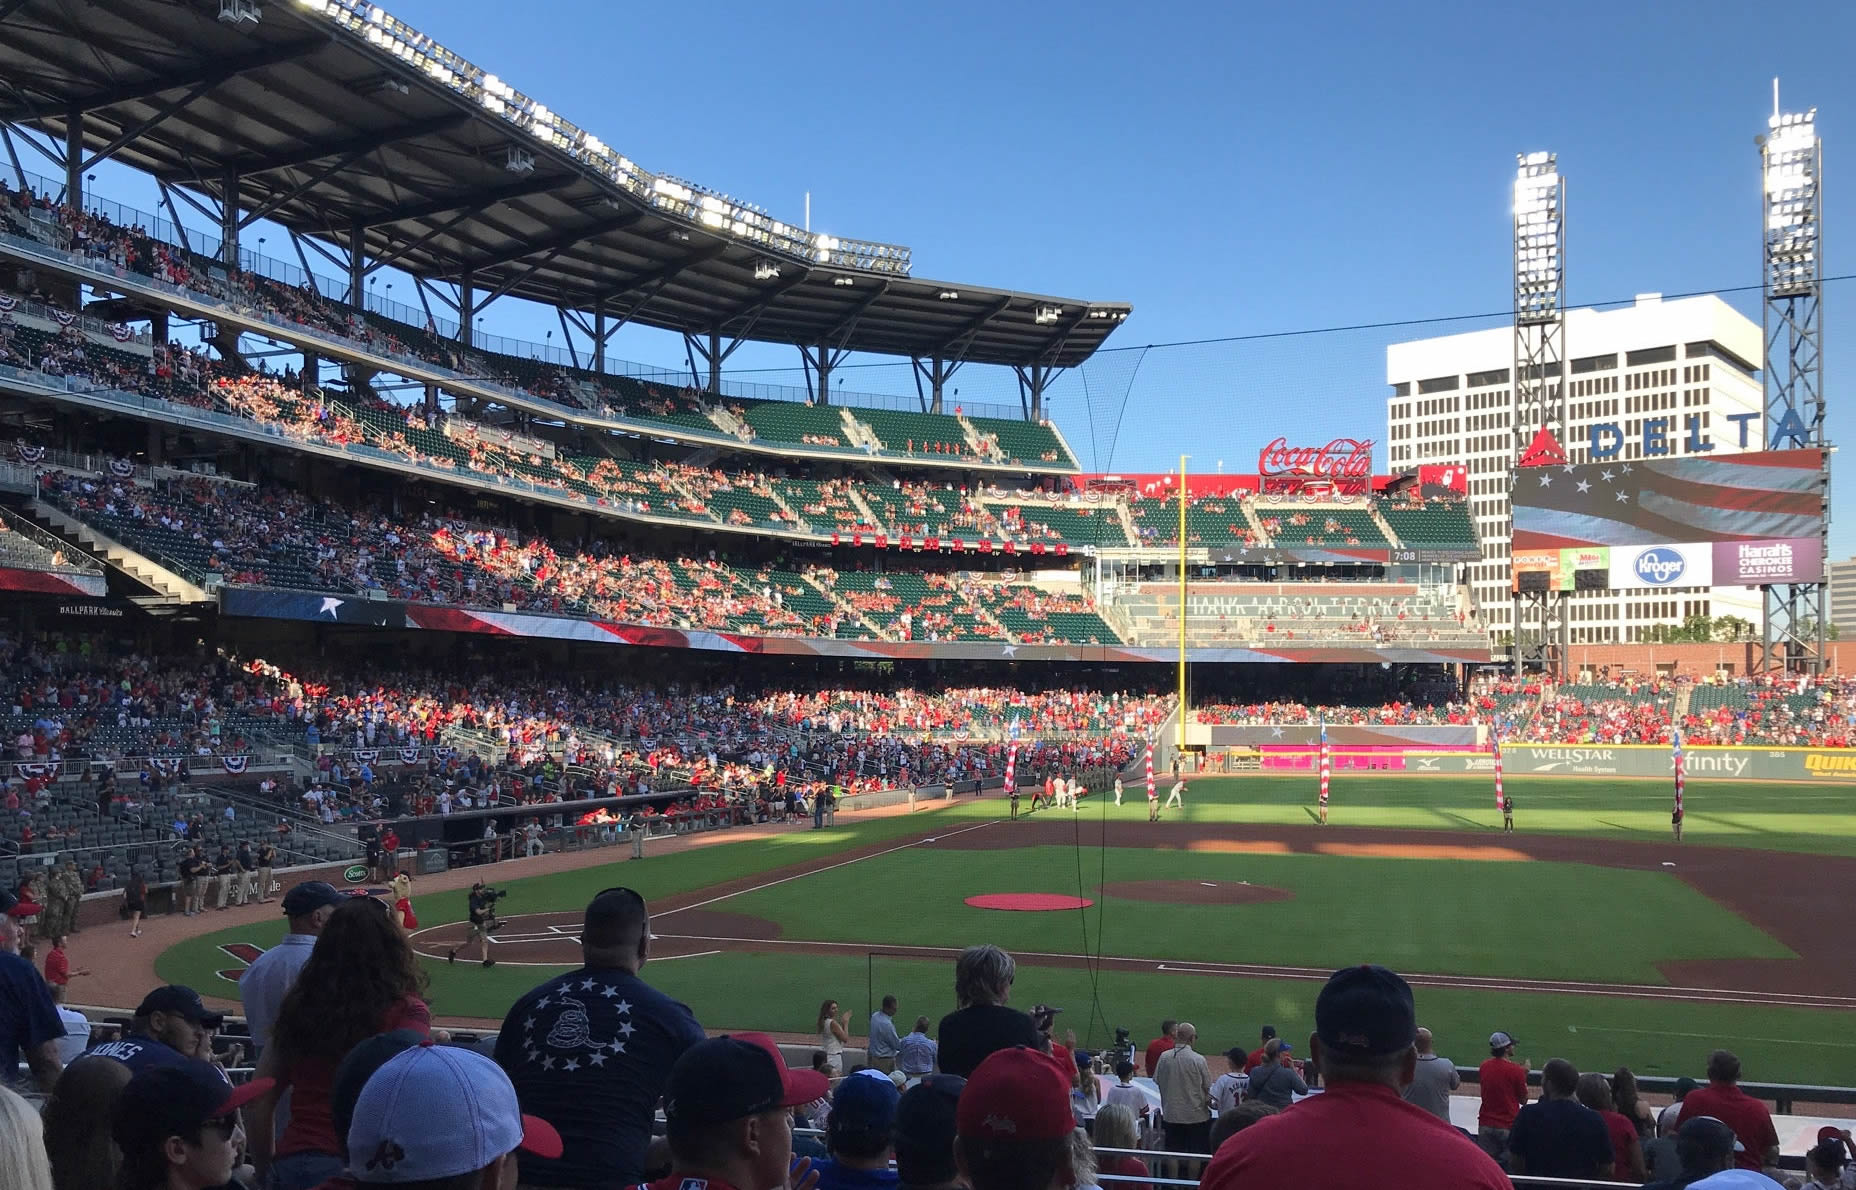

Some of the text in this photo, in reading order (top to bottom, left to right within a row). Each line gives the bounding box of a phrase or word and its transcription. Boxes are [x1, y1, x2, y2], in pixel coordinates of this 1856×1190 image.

[1590, 408, 1811, 458] DELTA
[1083, 545, 1096, 557] 42
[1394, 551, 1416, 561] 7:08
[1639, 553, 1683, 582] Kroger
[1739, 557, 1793, 566] CHEROKEE
[1739, 566, 1793, 574] CASINOS
[1187, 597, 1246, 615] HANK
[1252, 597, 1327, 615] AARON
[1531, 748, 1613, 762] WELLSTAR
